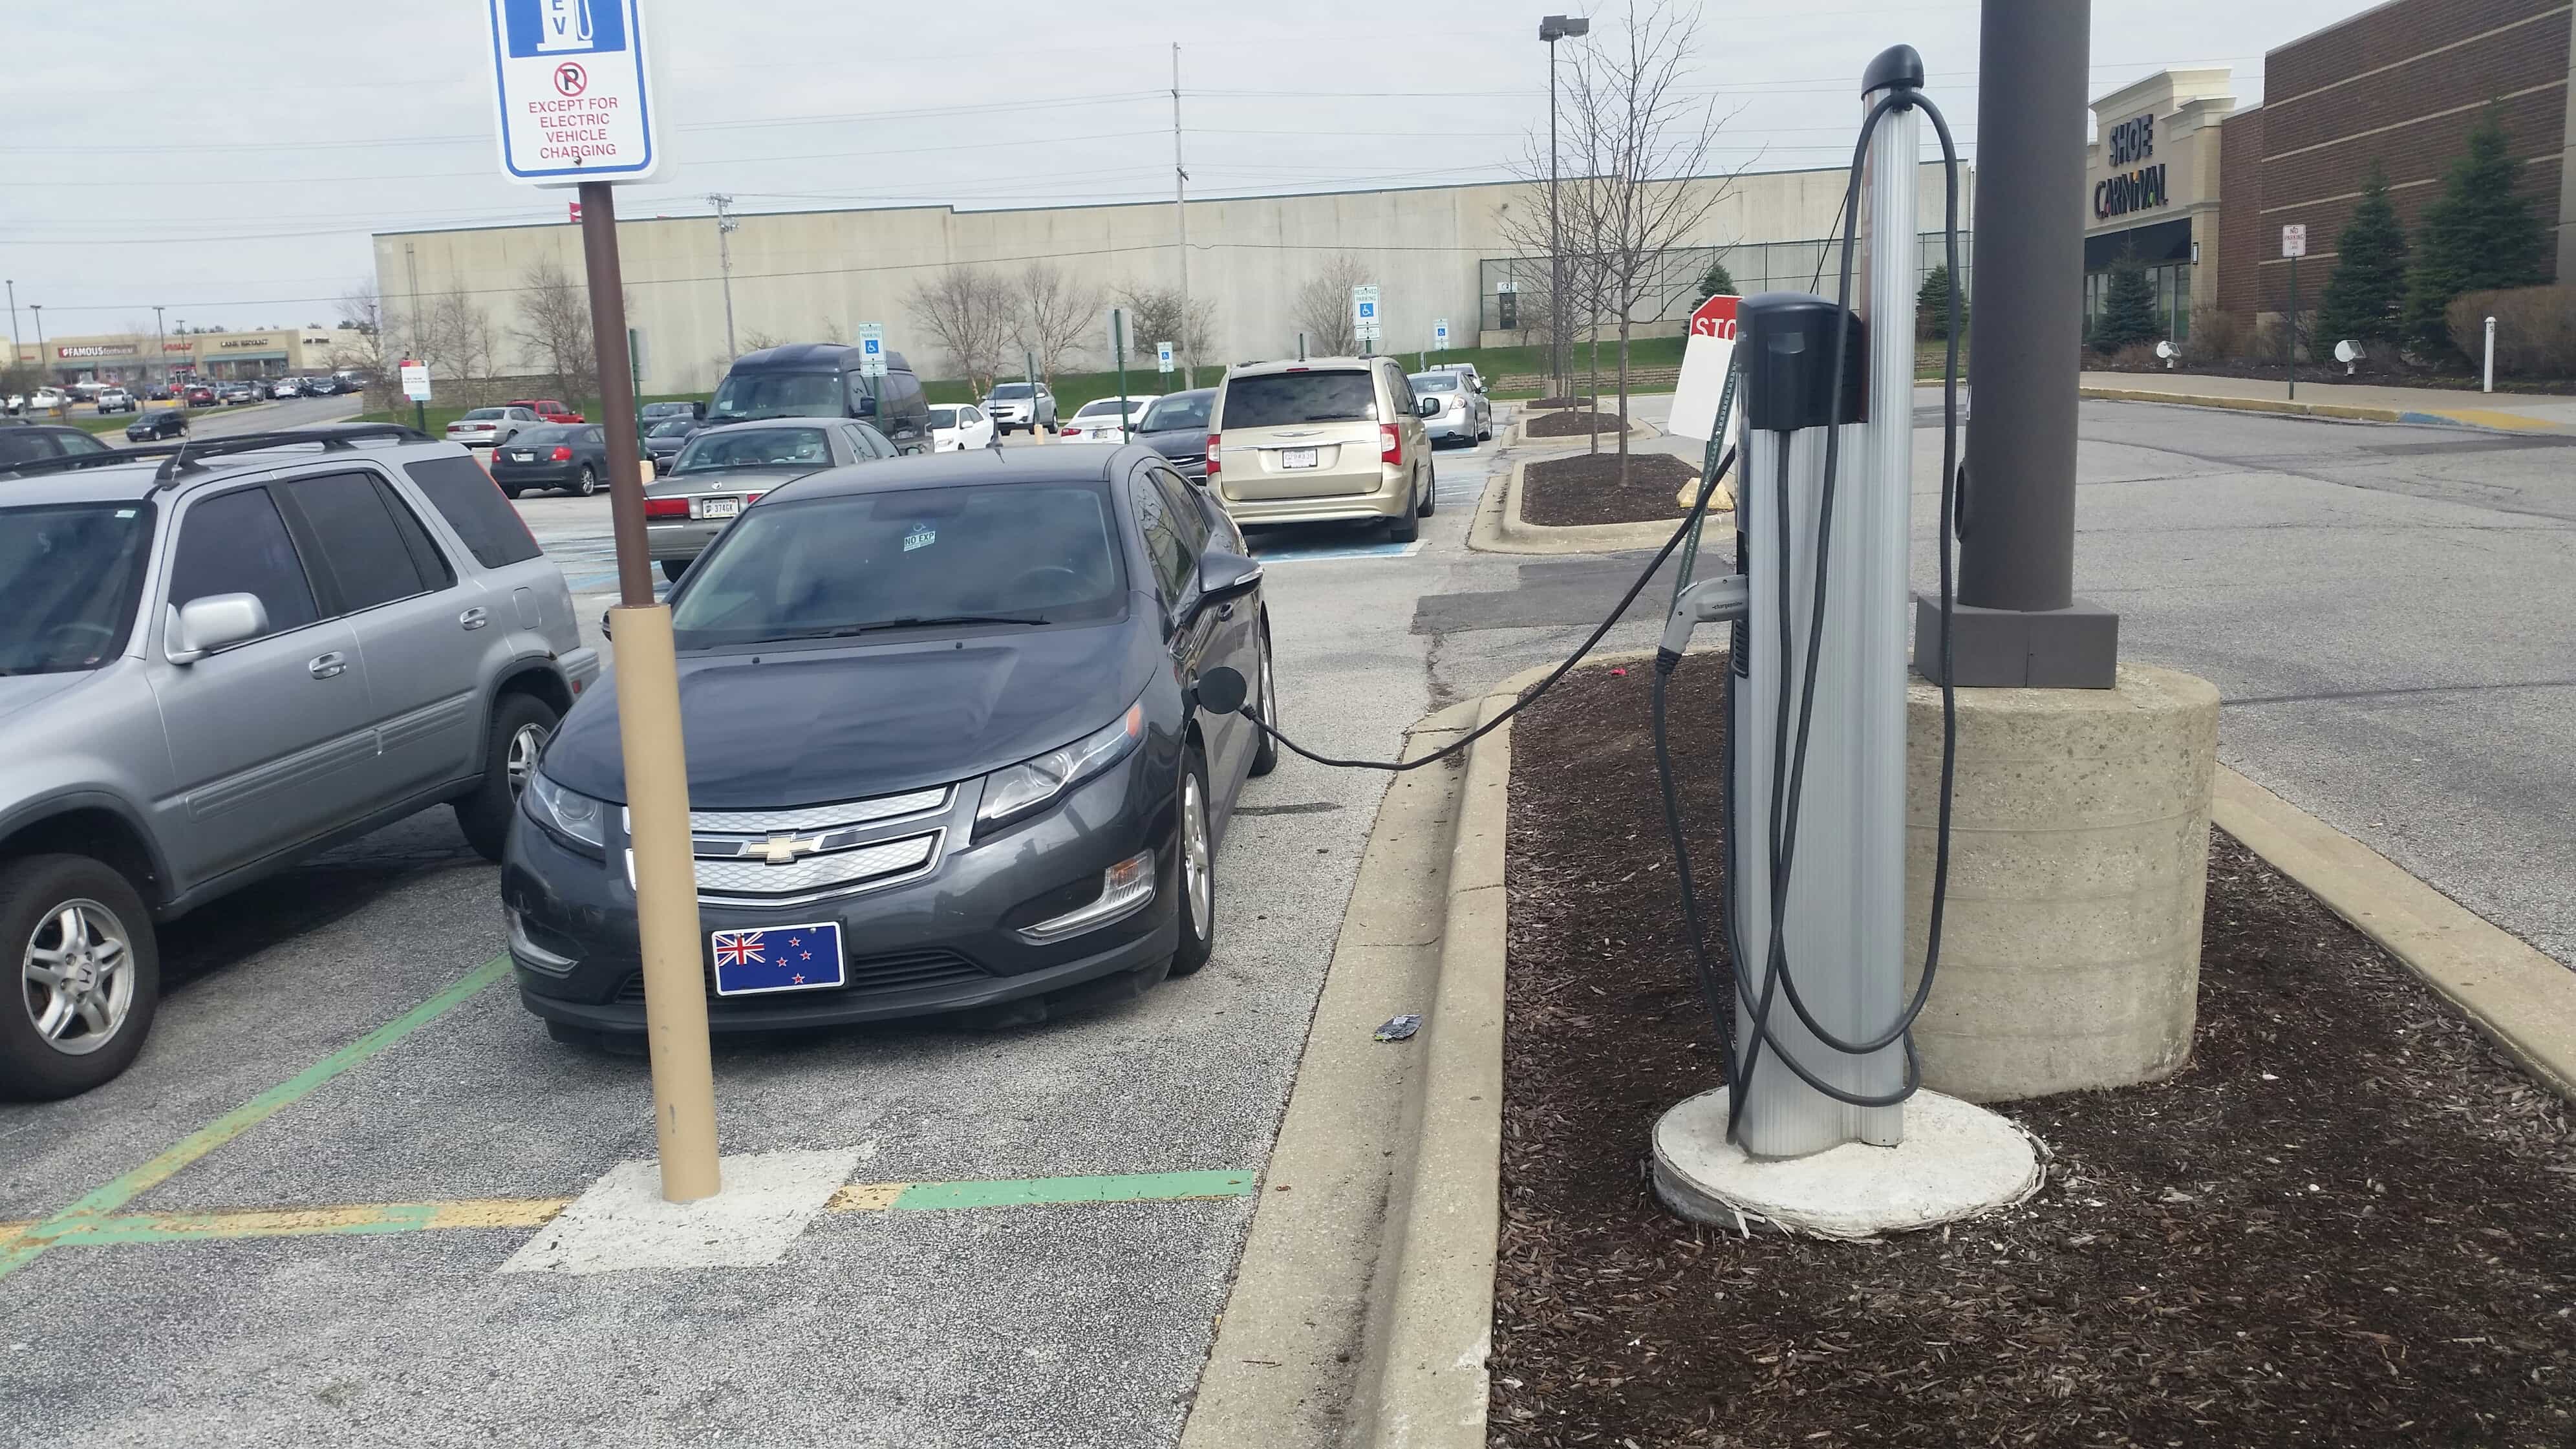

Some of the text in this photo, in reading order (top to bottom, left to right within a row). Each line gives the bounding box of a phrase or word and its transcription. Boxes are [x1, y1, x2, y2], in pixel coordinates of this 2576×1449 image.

[528, 97, 618, 114] EXCEPT FOR
[540, 113, 610, 128] ELECTRIC
[546, 128, 608, 144] VEHICLE
[2109, 114, 2153, 166] SHOE
[540, 144, 617, 159] CHARGING
[2094, 164, 2168, 219] CARNIVAL
[1692, 317, 1737, 341] STO
[69, 345, 104, 358] FAMOUS
[905, 531, 934, 545] NO EXP
